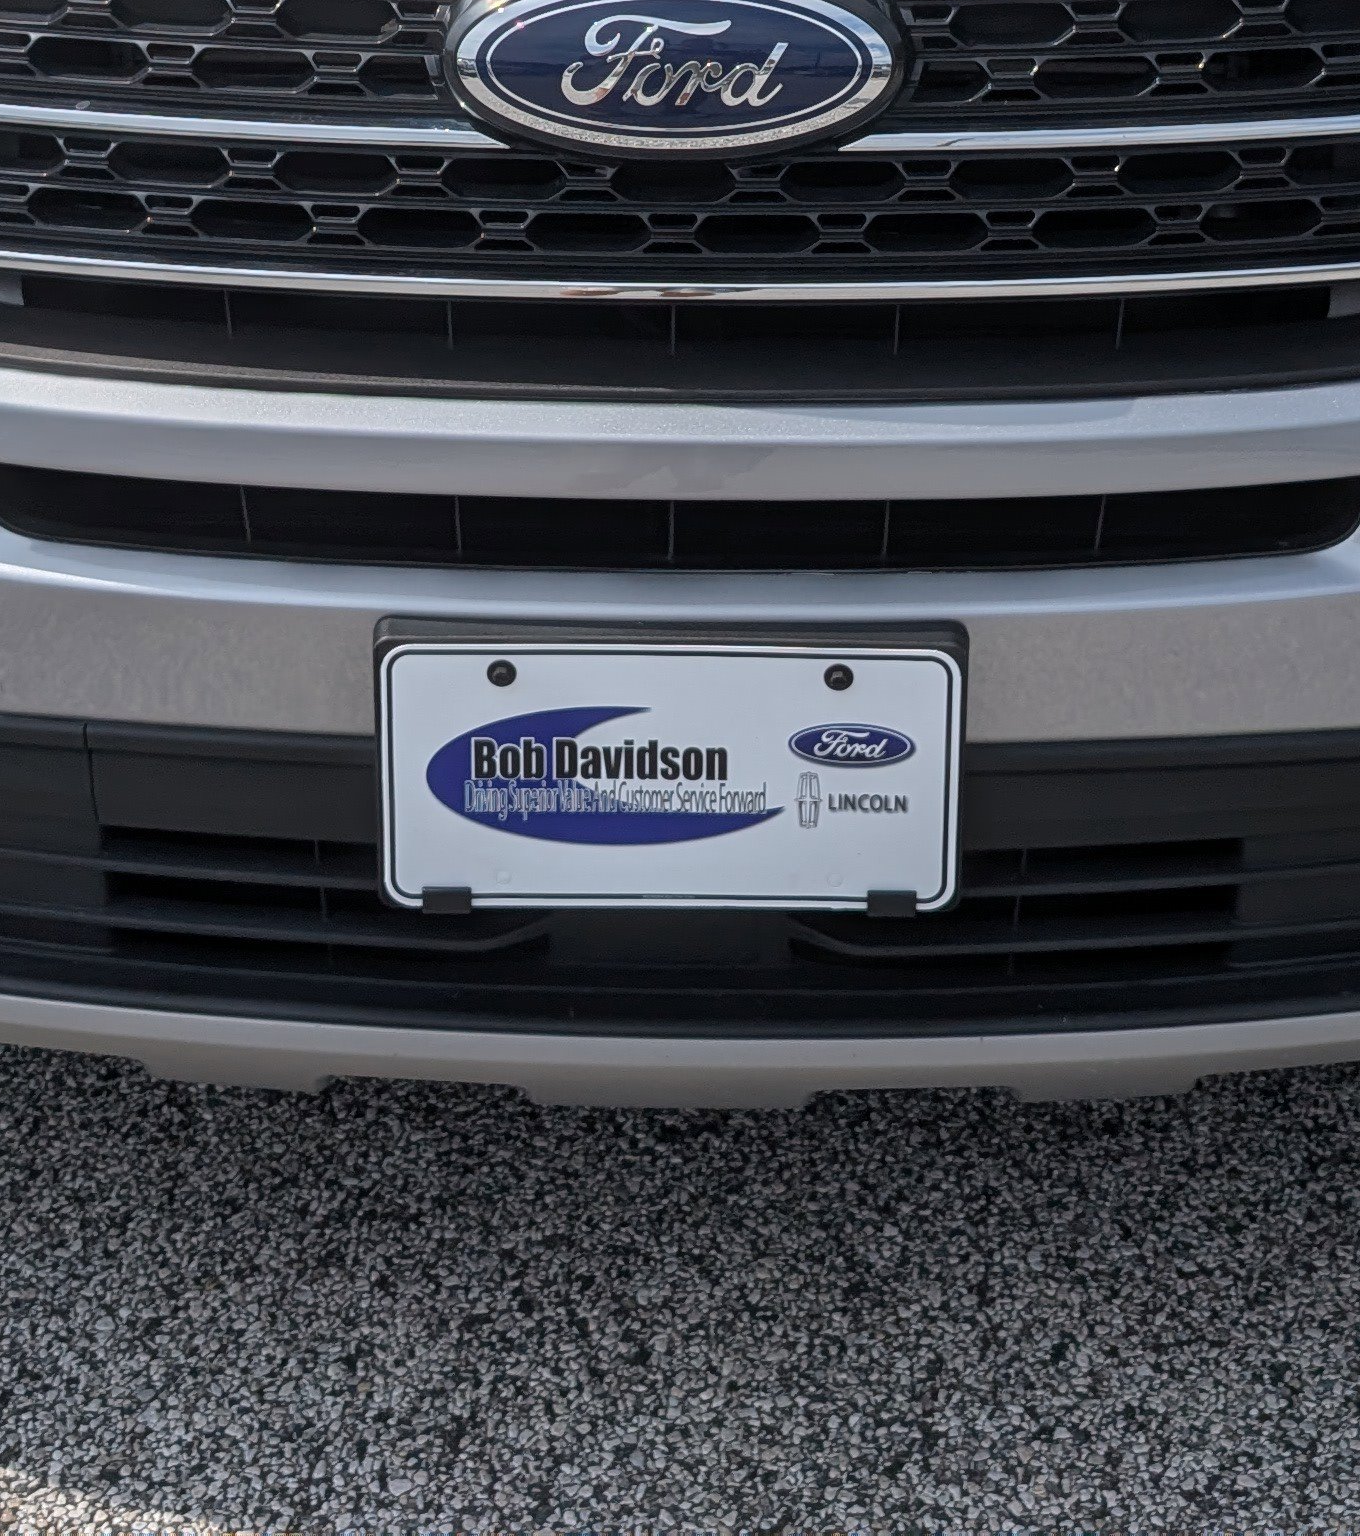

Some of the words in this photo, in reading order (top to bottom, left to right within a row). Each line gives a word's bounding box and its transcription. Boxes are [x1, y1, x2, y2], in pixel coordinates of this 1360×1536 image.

[561, 14, 789, 107] Ford
[473, 738, 545, 779] Bob
[554, 738, 728, 781] Davidson
[813, 729, 888, 758] Ford
[464, 780, 508, 821] Driving
[508, 780, 557, 821] Superior
[557, 779, 590, 812] Value
[590, 779, 617, 812] And
[618, 781, 674, 812] Customer
[675, 781, 717, 812] Service
[719, 781, 767, 813] Forward
[828, 793, 909, 813] LINCOLN
